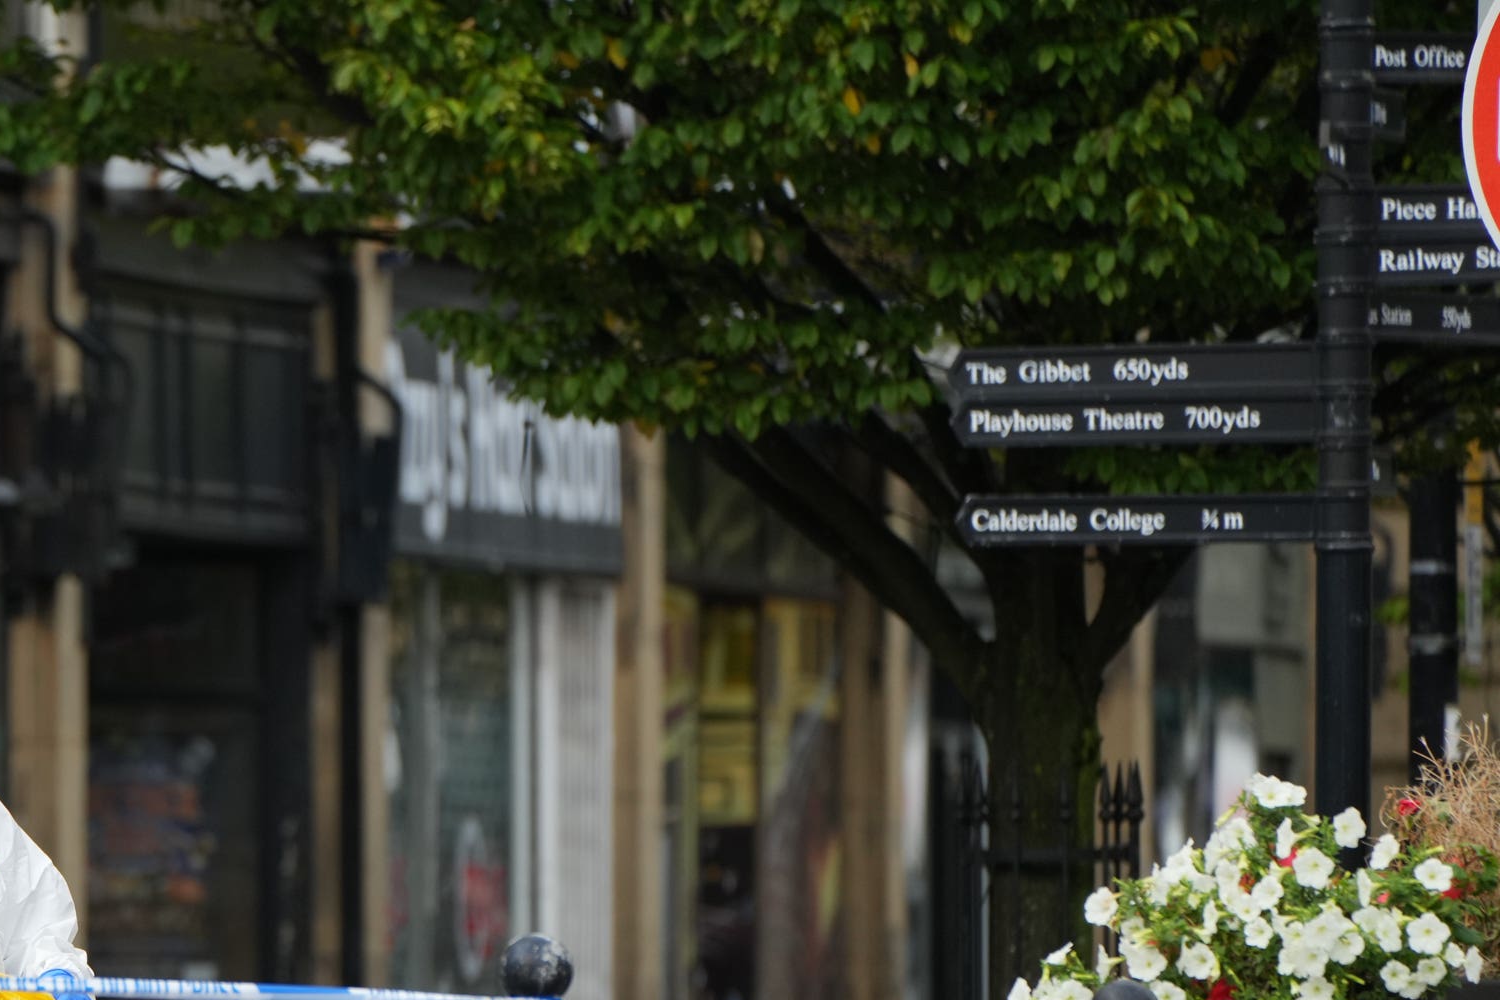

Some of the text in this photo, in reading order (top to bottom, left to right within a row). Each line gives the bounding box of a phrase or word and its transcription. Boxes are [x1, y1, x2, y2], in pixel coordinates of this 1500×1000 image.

[1375, 44, 1465, 68] Post Office
[1381, 197, 1482, 220] Piece Ha
[1379, 248, 1465, 275] Railway
[966, 357, 1189, 386] The Gibbet 650yds
[970, 406, 1260, 438] Playhouse Theatre 700yds
[971, 508, 1077, 532] Calderdale
[1090, 508, 1165, 536] College
